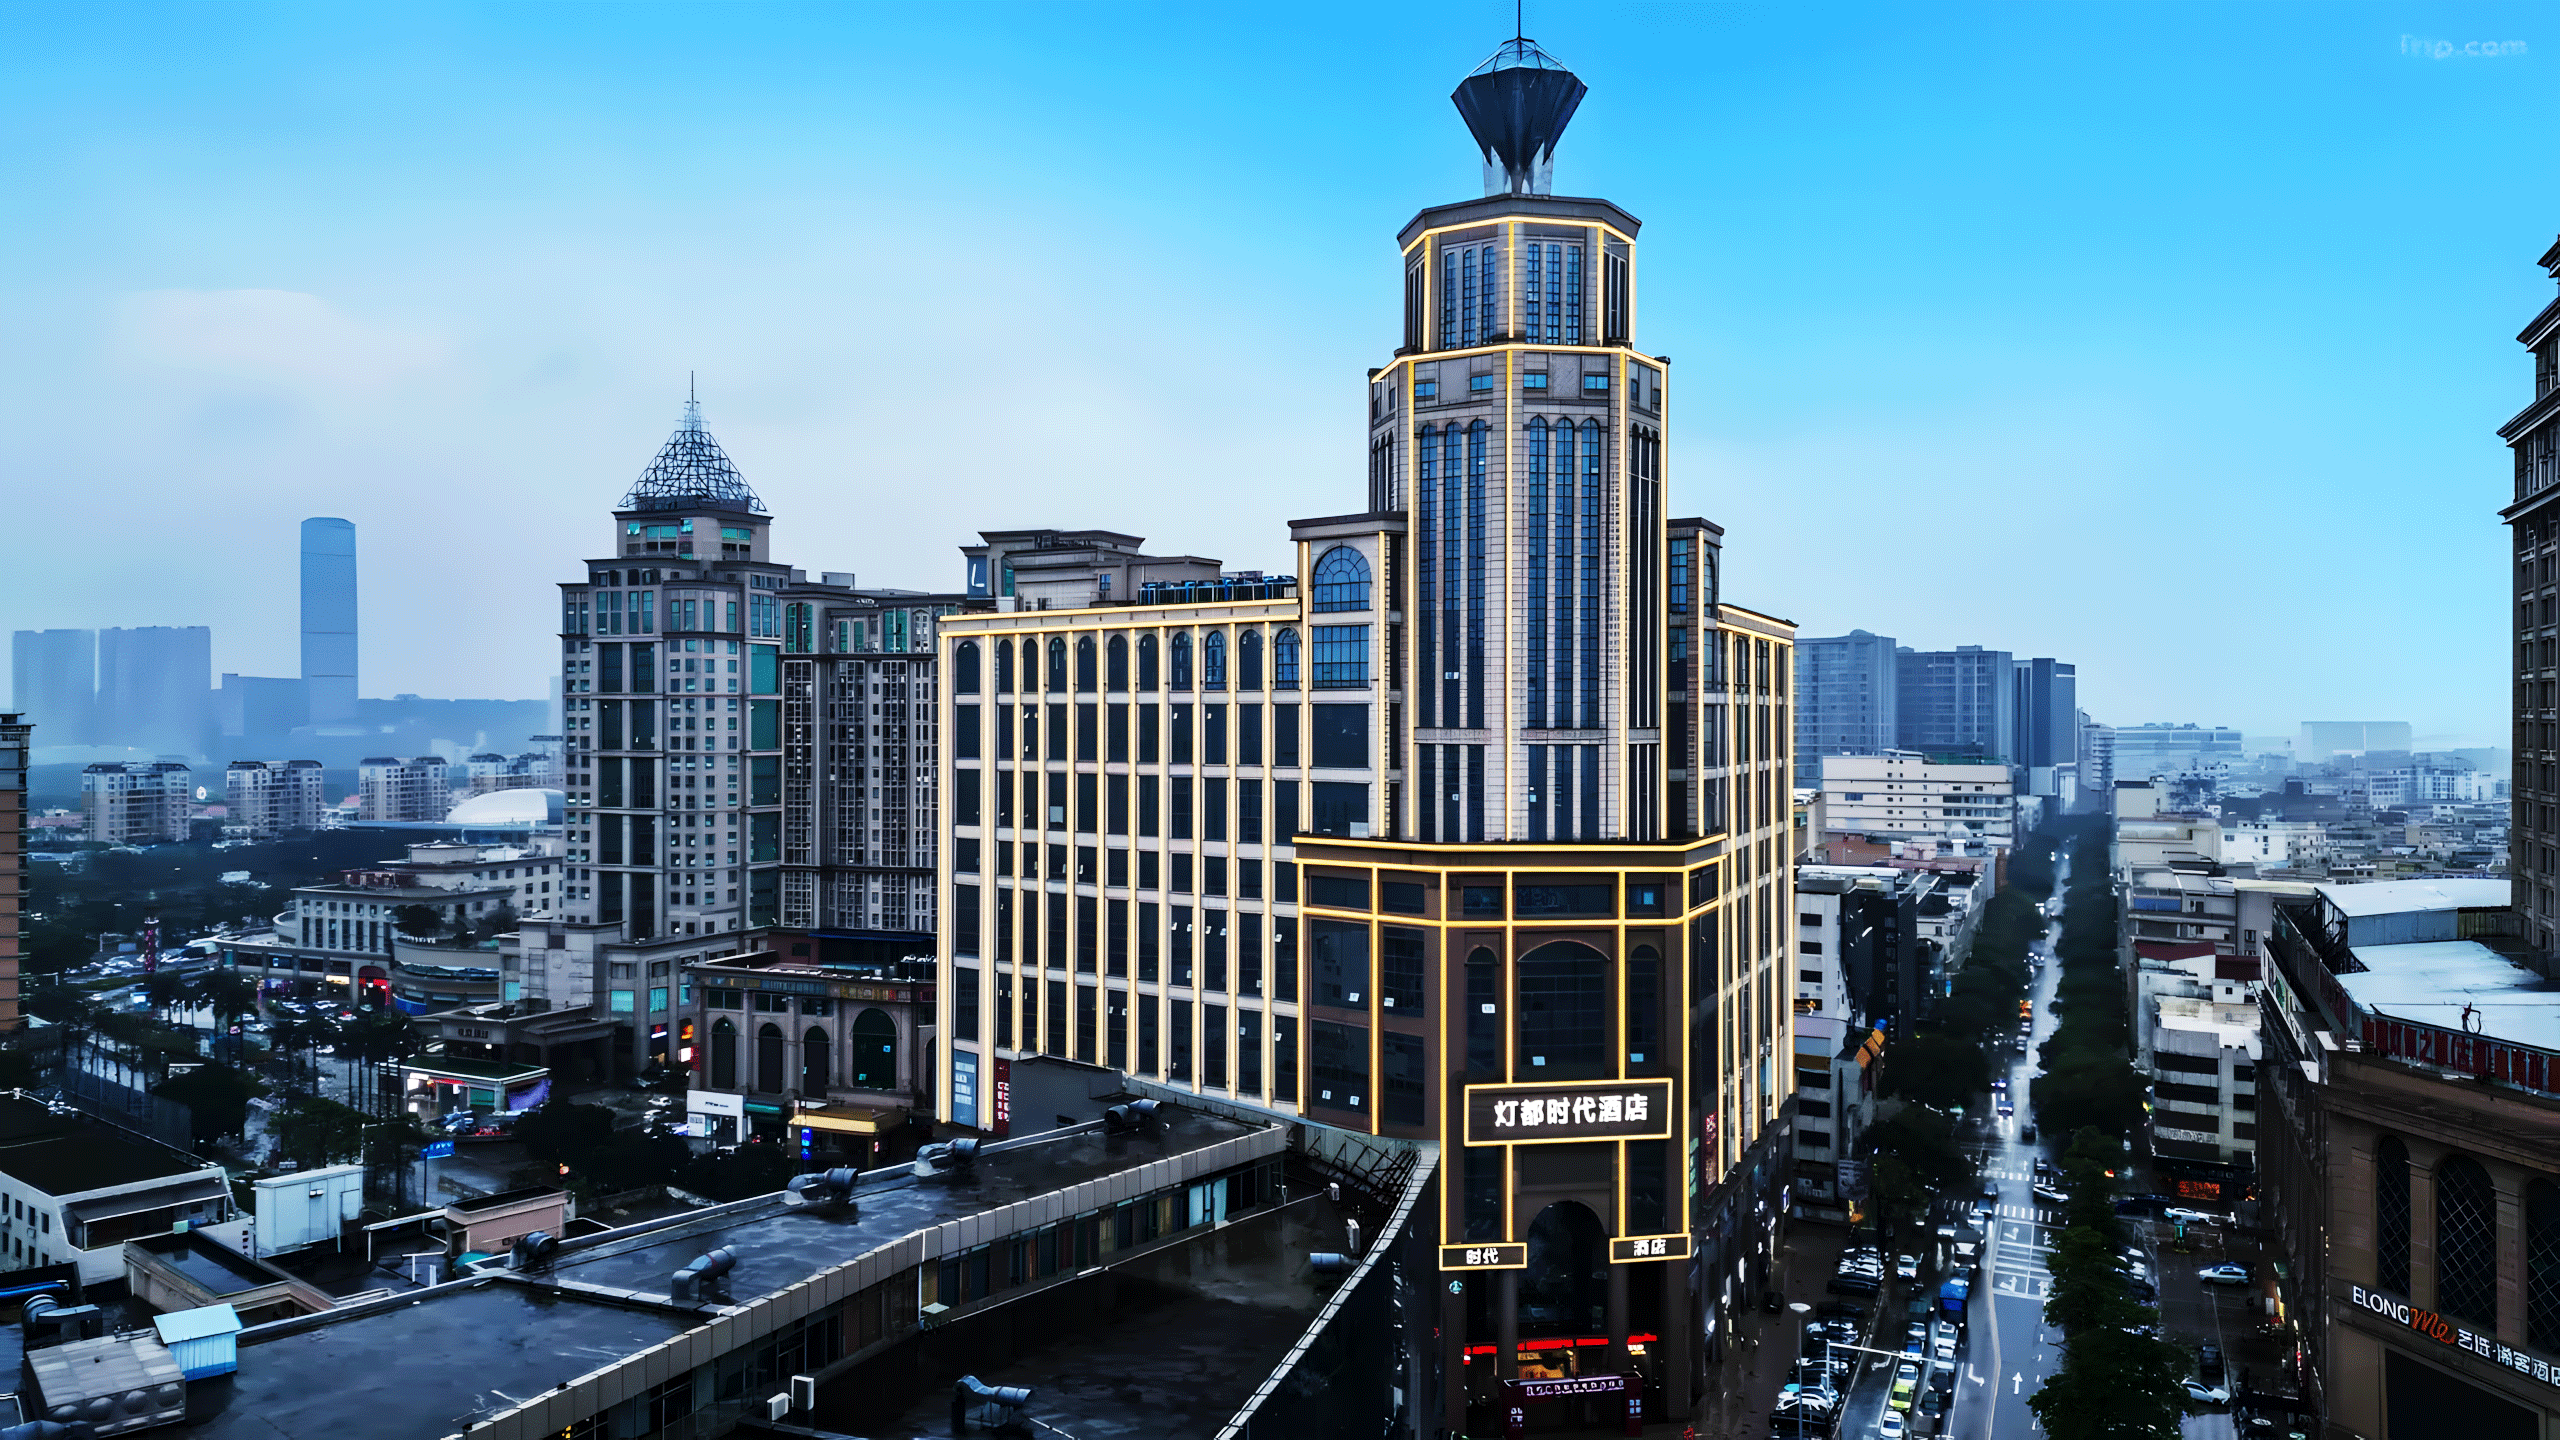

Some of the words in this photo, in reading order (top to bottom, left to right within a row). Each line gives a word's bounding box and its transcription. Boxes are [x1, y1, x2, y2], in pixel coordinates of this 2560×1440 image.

[1494, 1093, 1648, 1127] 灯都时代酒店
[1466, 1247, 1499, 1265] 时代
[1633, 1238, 1667, 1256] 酒店
[2353, 1285, 2410, 1325] ELONG
